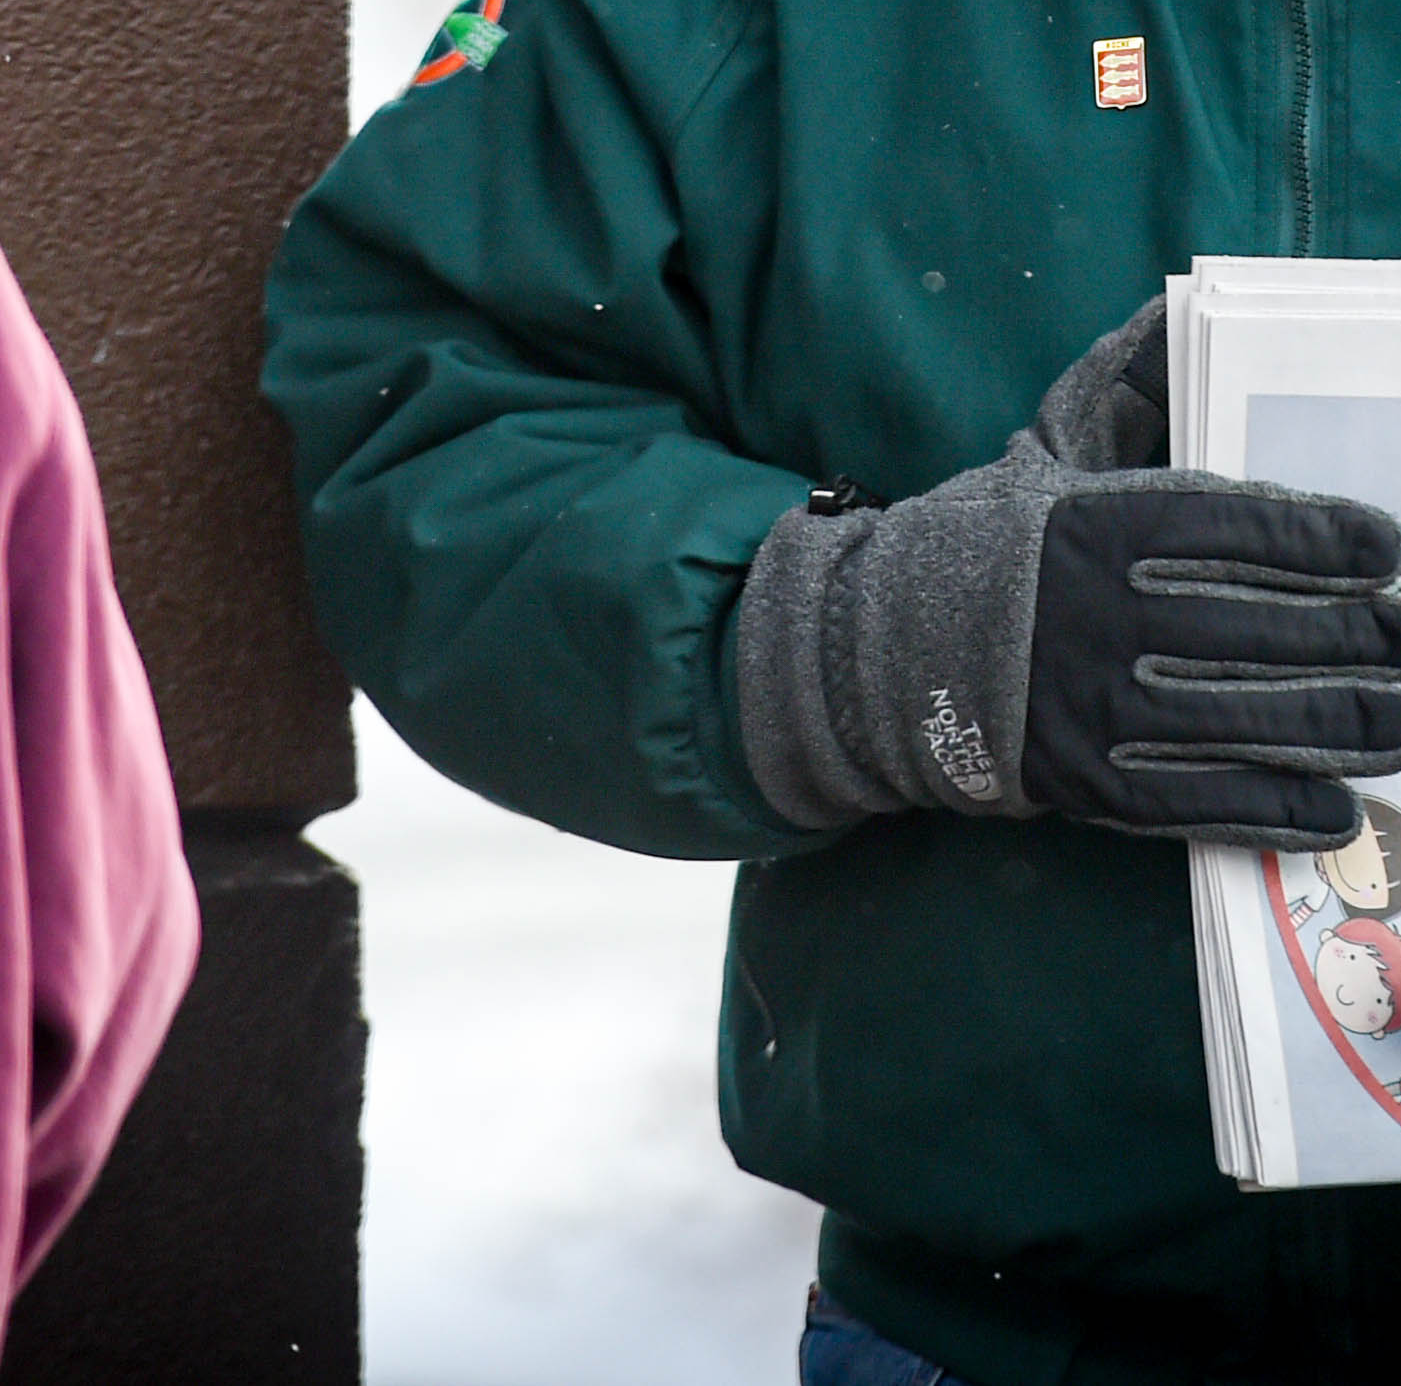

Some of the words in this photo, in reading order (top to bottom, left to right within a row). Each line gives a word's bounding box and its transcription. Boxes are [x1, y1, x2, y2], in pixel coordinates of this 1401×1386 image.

[921, 717, 958, 775] FACE
[929, 687, 979, 774] NORTH
[961, 720, 996, 775] THE
